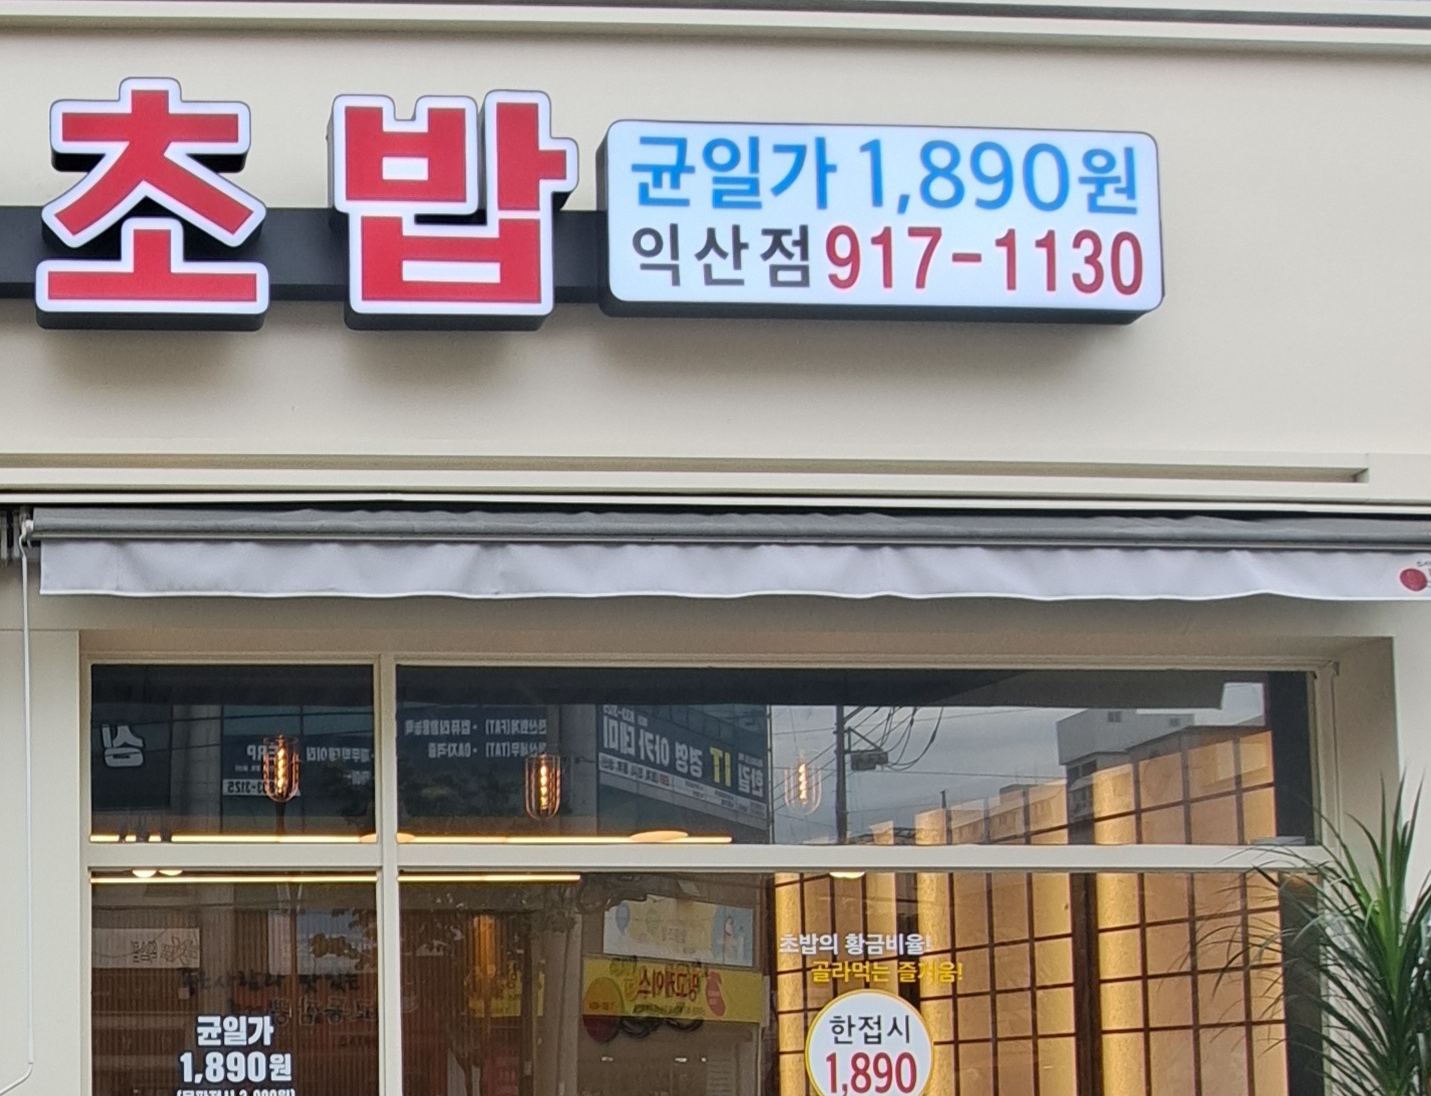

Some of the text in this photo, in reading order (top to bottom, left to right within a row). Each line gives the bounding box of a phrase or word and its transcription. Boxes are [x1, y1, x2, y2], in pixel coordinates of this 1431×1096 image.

[630, 135, 1139, 215] 균일가 1,890원
[631, 223, 1144, 296] 익산점 917-1130
[779, 932, 932, 956] 초밥의 황금비율!
[811, 961, 964, 984] 골라먹는 즐거움!
[196, 1015, 274, 1046] 균일가
[829, 1014, 911, 1045] 한접시
[179, 1050, 292, 1084] 1,890원
